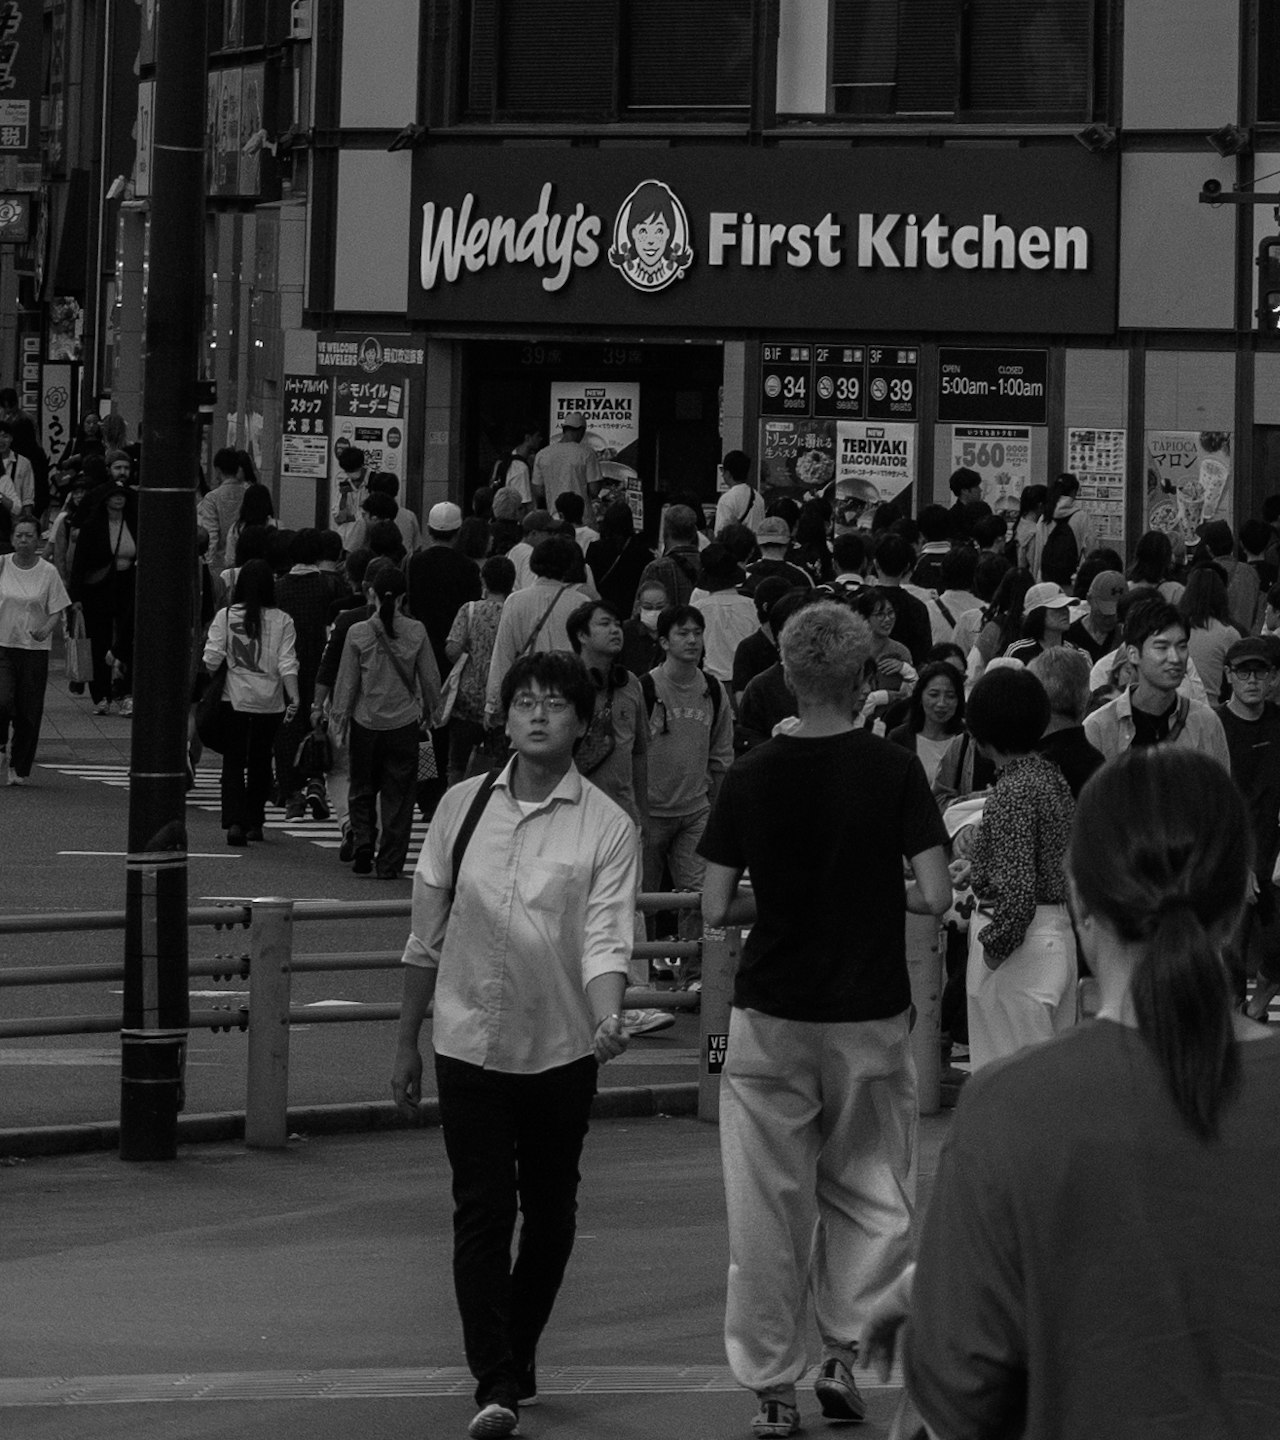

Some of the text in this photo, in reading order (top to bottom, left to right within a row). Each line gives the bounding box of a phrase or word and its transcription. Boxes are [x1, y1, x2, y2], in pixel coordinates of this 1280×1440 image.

[419, 180, 1089, 292] Wendy's First Kitchen
[764, 347, 782, 361] B1F
[816, 348, 830, 362] 2F
[870, 350, 883, 364] 3F
[942, 364, 1024, 375] OPEN CLOSED
[349, 382, 389, 399] モバイル
[783, 375, 806, 399] 34
[836, 377, 860, 400] 39
[889, 378, 913, 401] 39
[290, 397, 323, 415] スタッフ
[348, 398, 388, 414] オーダー
[558, 397, 632, 411] TERIYAKI
[842, 438, 908, 456] TERIYAKI
[1151, 440, 1198, 453] TAPIOCA
[841, 454, 908, 468] BACONATOR
[1151, 452, 1198, 469] マロン
